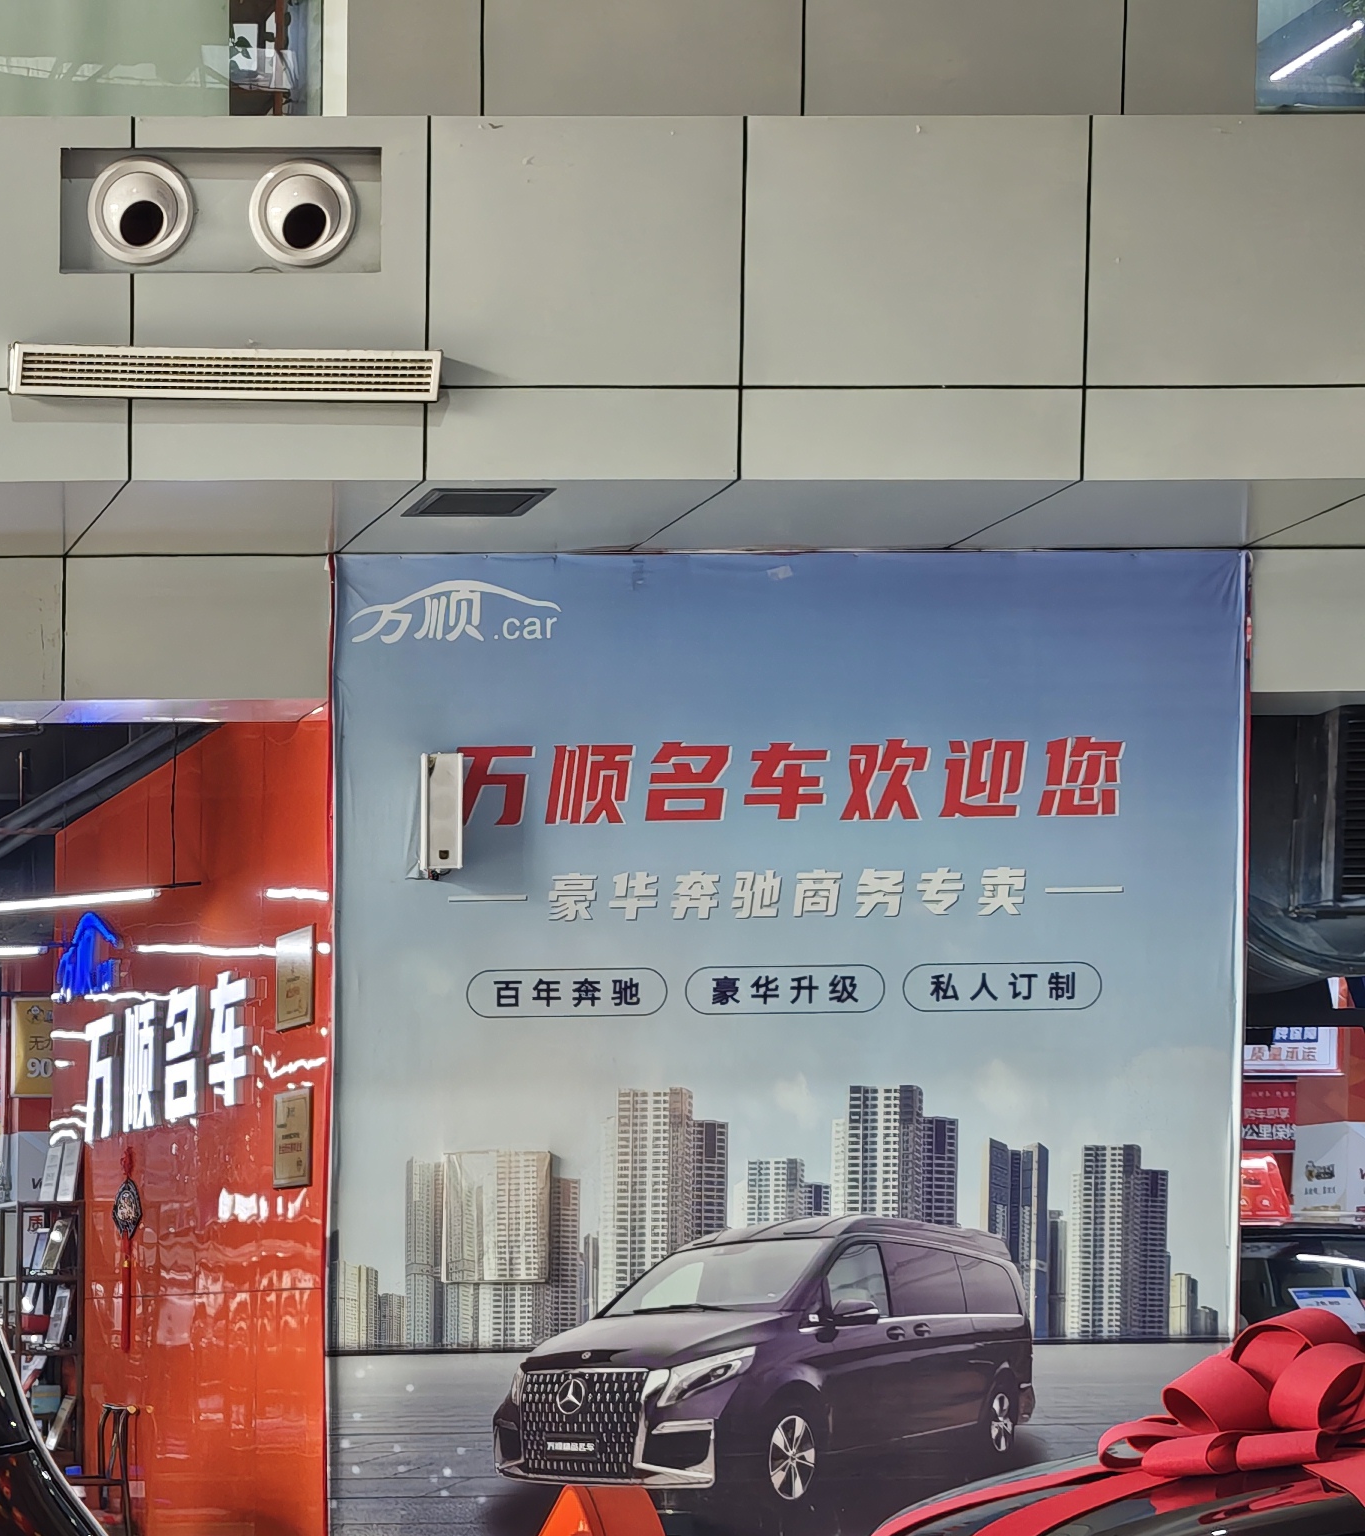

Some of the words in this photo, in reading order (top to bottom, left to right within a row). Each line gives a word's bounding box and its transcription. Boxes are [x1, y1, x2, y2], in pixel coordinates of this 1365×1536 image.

[457, 735, 1127, 827] 万顺名车欢迎您
[548, 866, 1027, 922] 豪华奔驰商务专卖
[493, 978, 642, 1008] 百年奔驰
[710, 974, 859, 1006] 豪华升级
[929, 971, 1079, 1003] 私人订制
[83, 968, 251, 1144] 万顺名车
